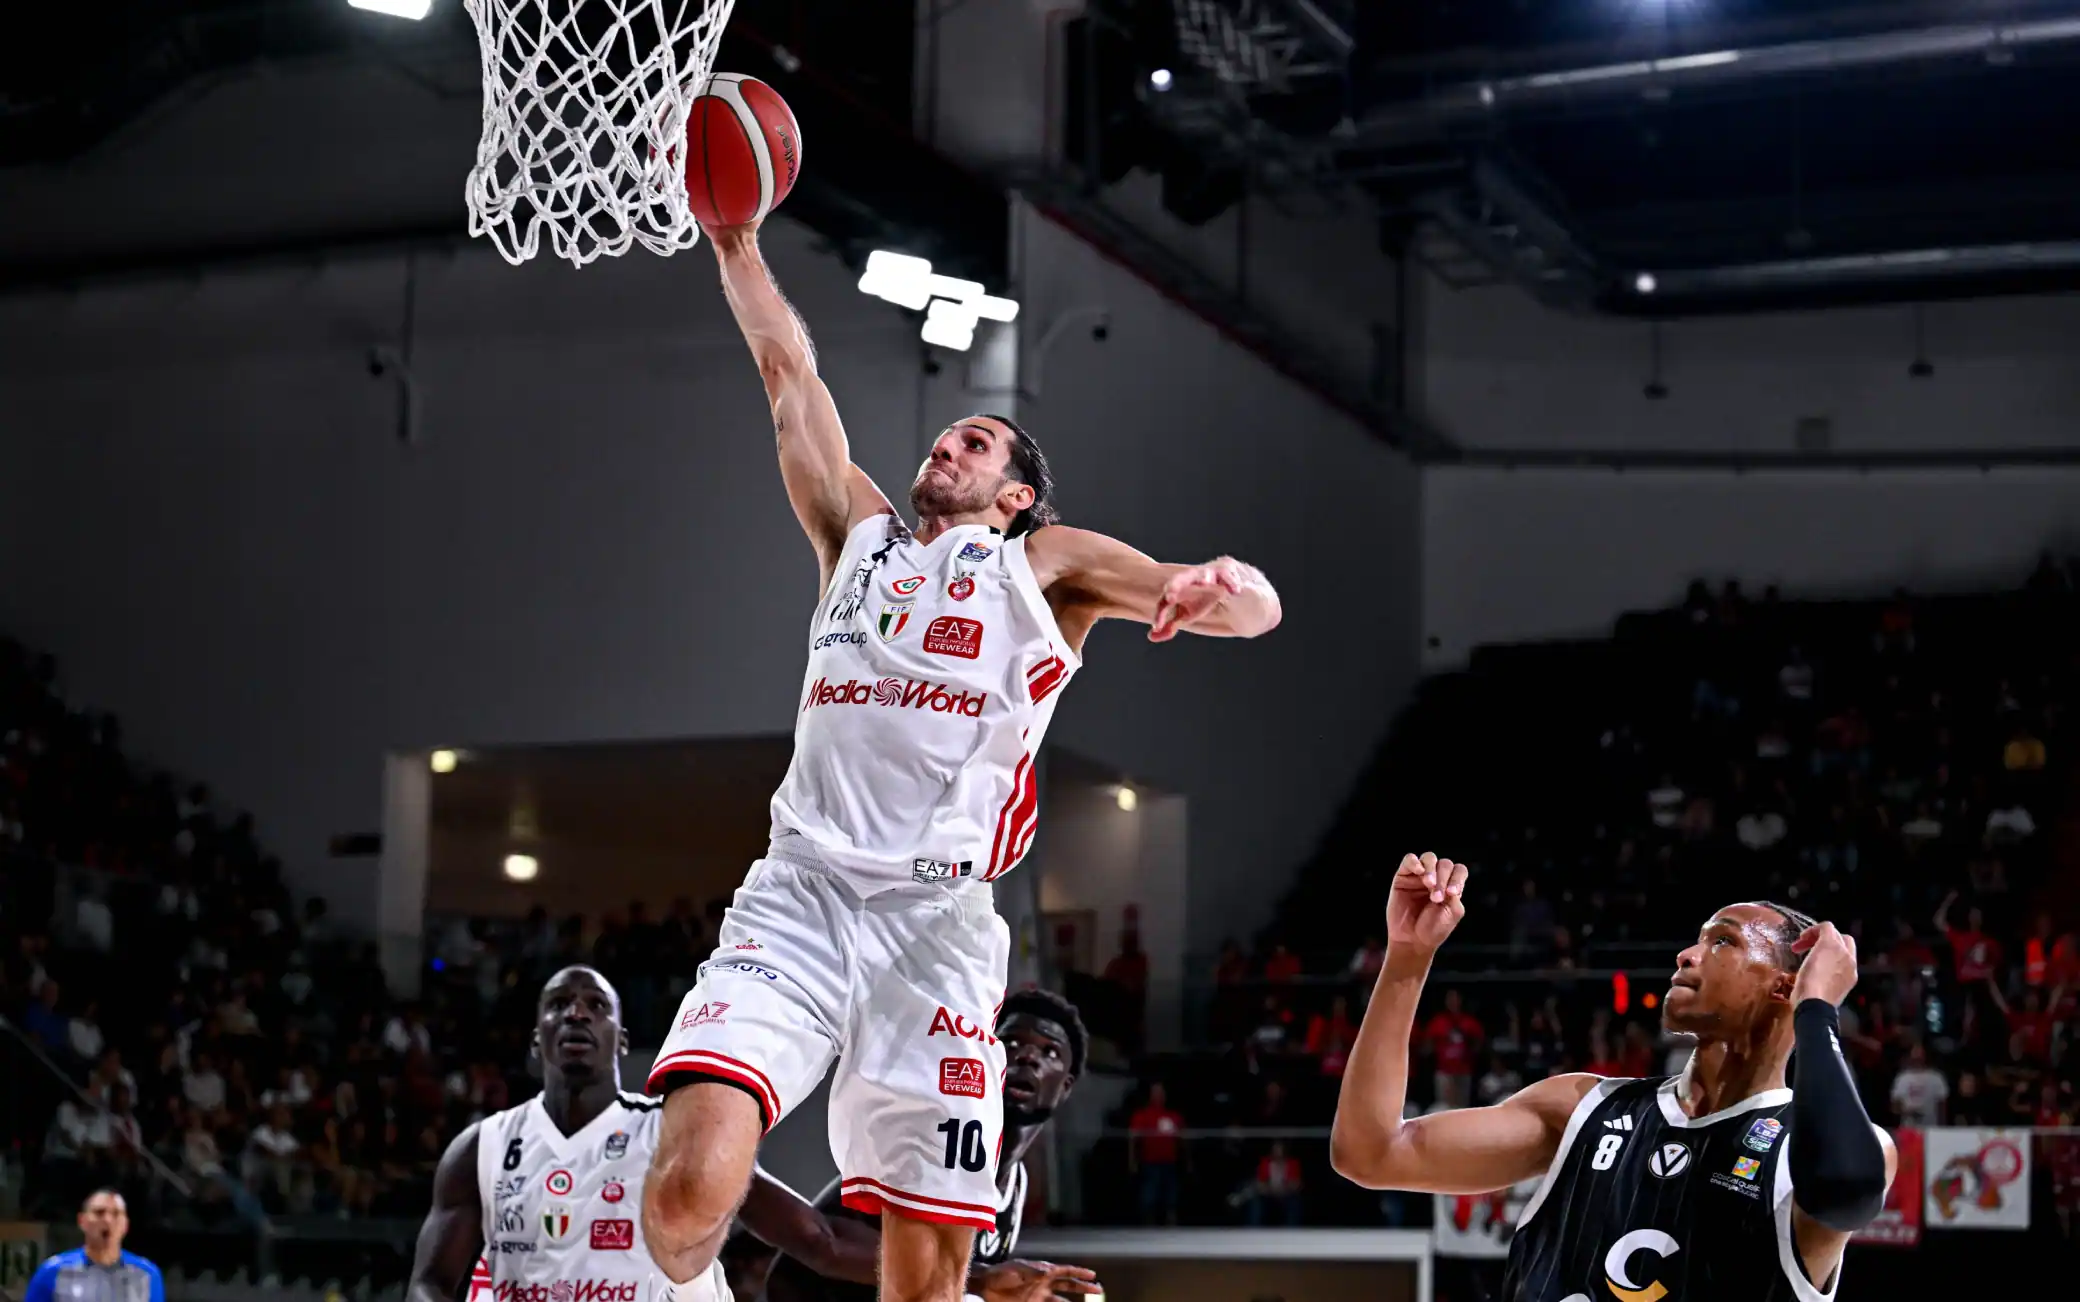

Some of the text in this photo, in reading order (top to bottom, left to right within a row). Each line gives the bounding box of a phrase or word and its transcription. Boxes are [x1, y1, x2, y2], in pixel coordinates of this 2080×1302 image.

[929, 620, 979, 641] EA7
[928, 642, 975, 655] EYEWEAR
[803, 676, 988, 718] Media World
[914, 858, 951, 876] EA7
[681, 1001, 731, 1026] EA7
[944, 1062, 982, 1081] EA7
[944, 1084, 982, 1095] EYEWEAR
[503, 1137, 523, 1171] 6
[937, 1117, 987, 1173] 10
[1591, 1134, 1624, 1171] 8
[594, 1222, 629, 1238] EA7
[573, 1279, 638, 1302] World
